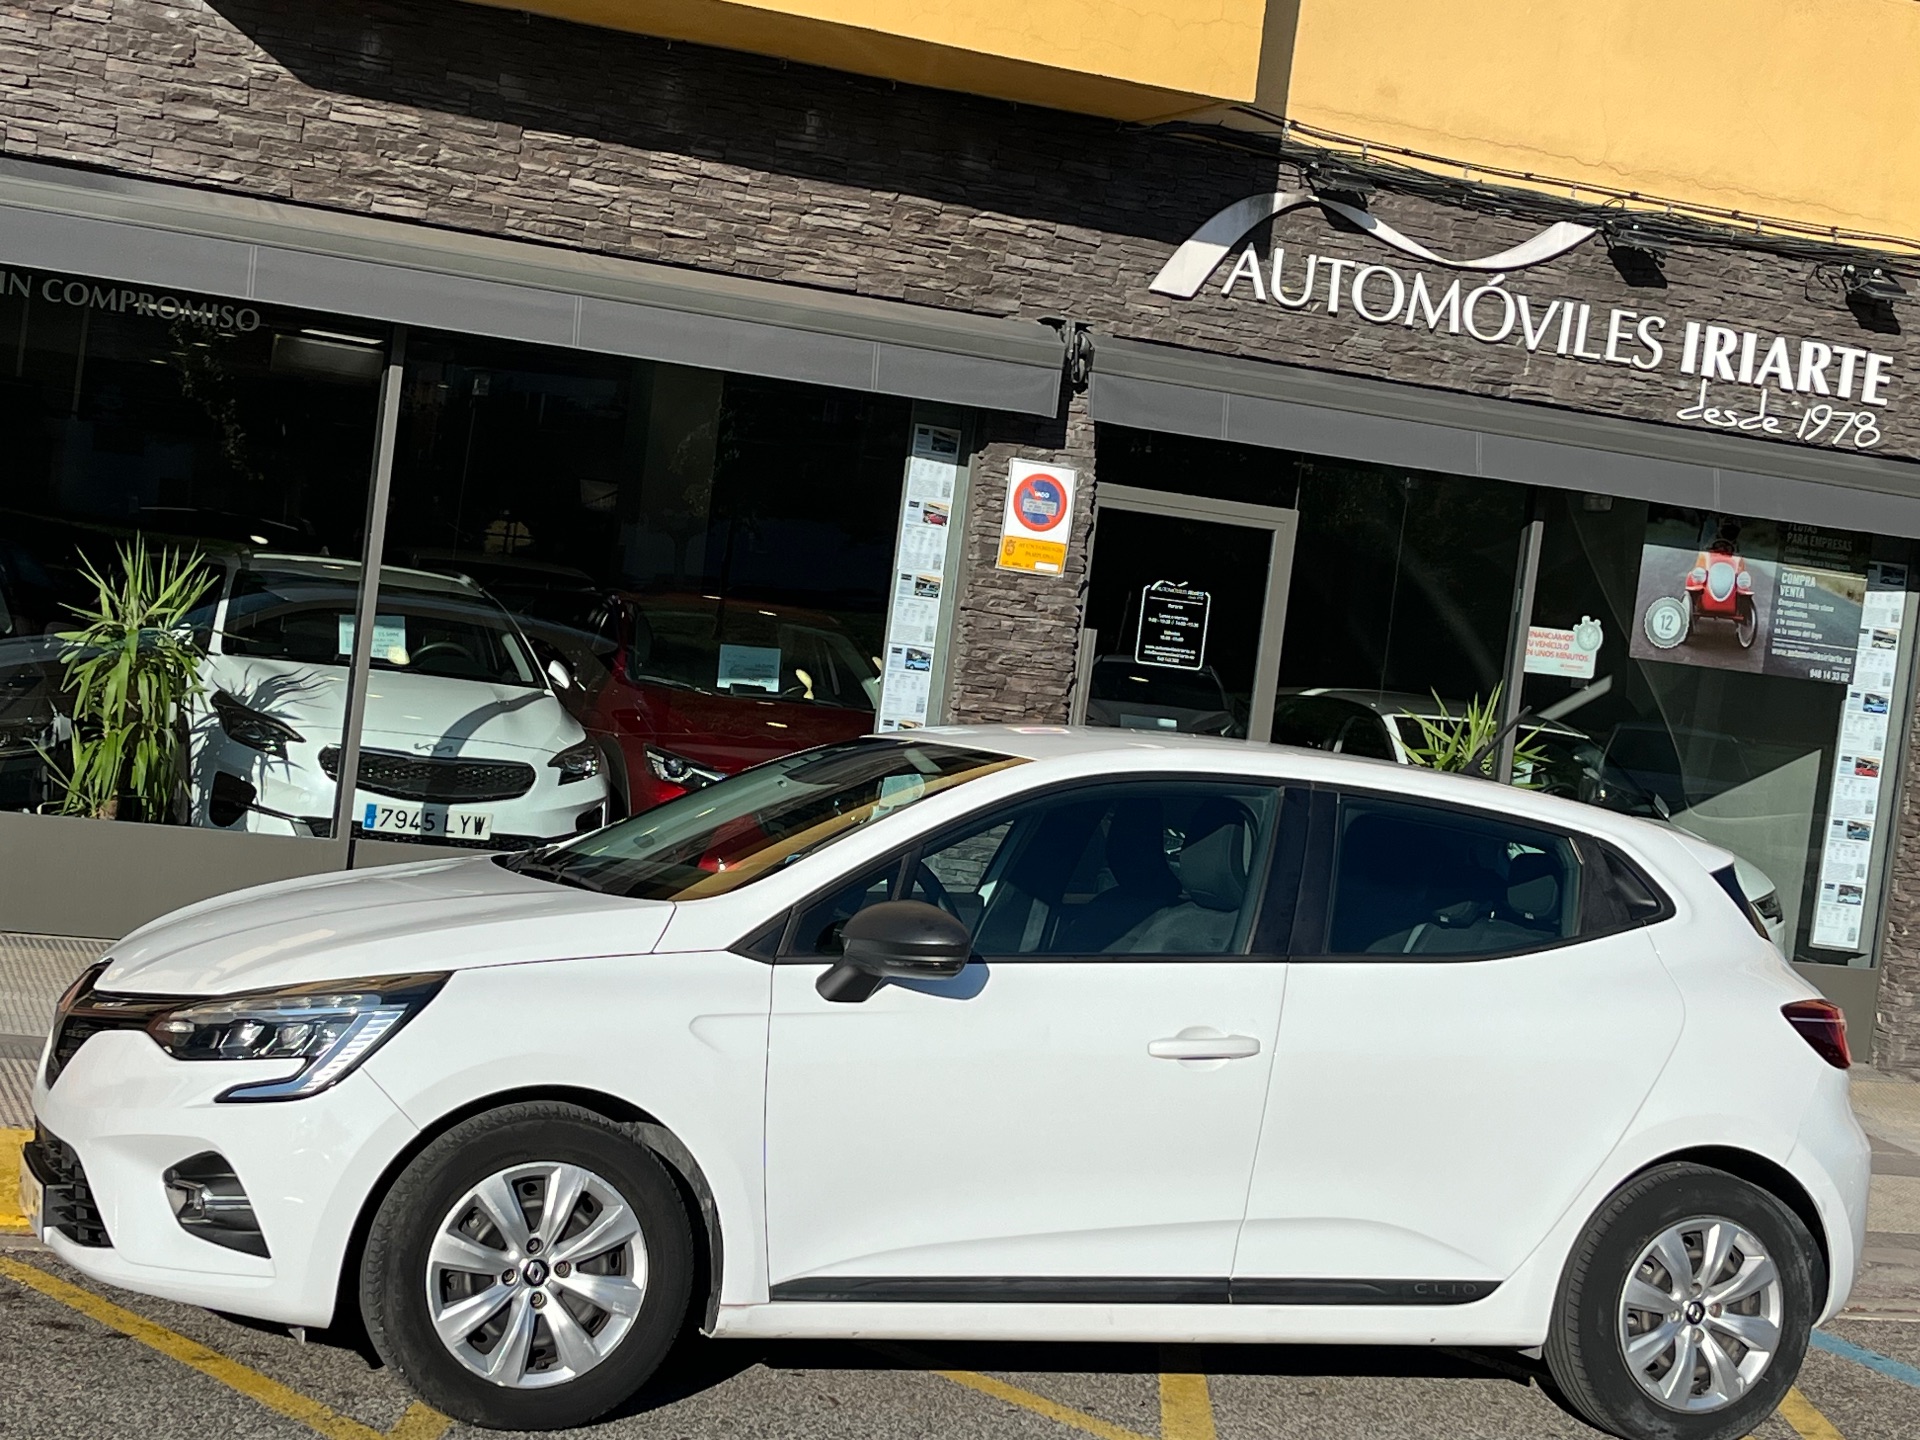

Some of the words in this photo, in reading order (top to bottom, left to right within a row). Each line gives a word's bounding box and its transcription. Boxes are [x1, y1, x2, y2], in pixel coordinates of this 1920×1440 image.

[42, 278, 261, 332] COMPROMISO
[1221, 241, 1665, 371] AUTOMÓVILES
[1680, 322, 1894, 406] IRIARTE
[1677, 379, 1783, 434] desde
[1798, 404, 1882, 448] 1978
[1810, 535, 1853, 552] EMPRESAS
[1781, 572, 1817, 588] COMPRA
[1779, 584, 1805, 599] VENTA
[1661, 614, 1673, 631] 12
[1534, 649, 1554, 659] UNOS
[380, 808, 436, 832] 7945
[443, 813, 487, 836] LYW
[1414, 1282, 1477, 1295] CLIO
